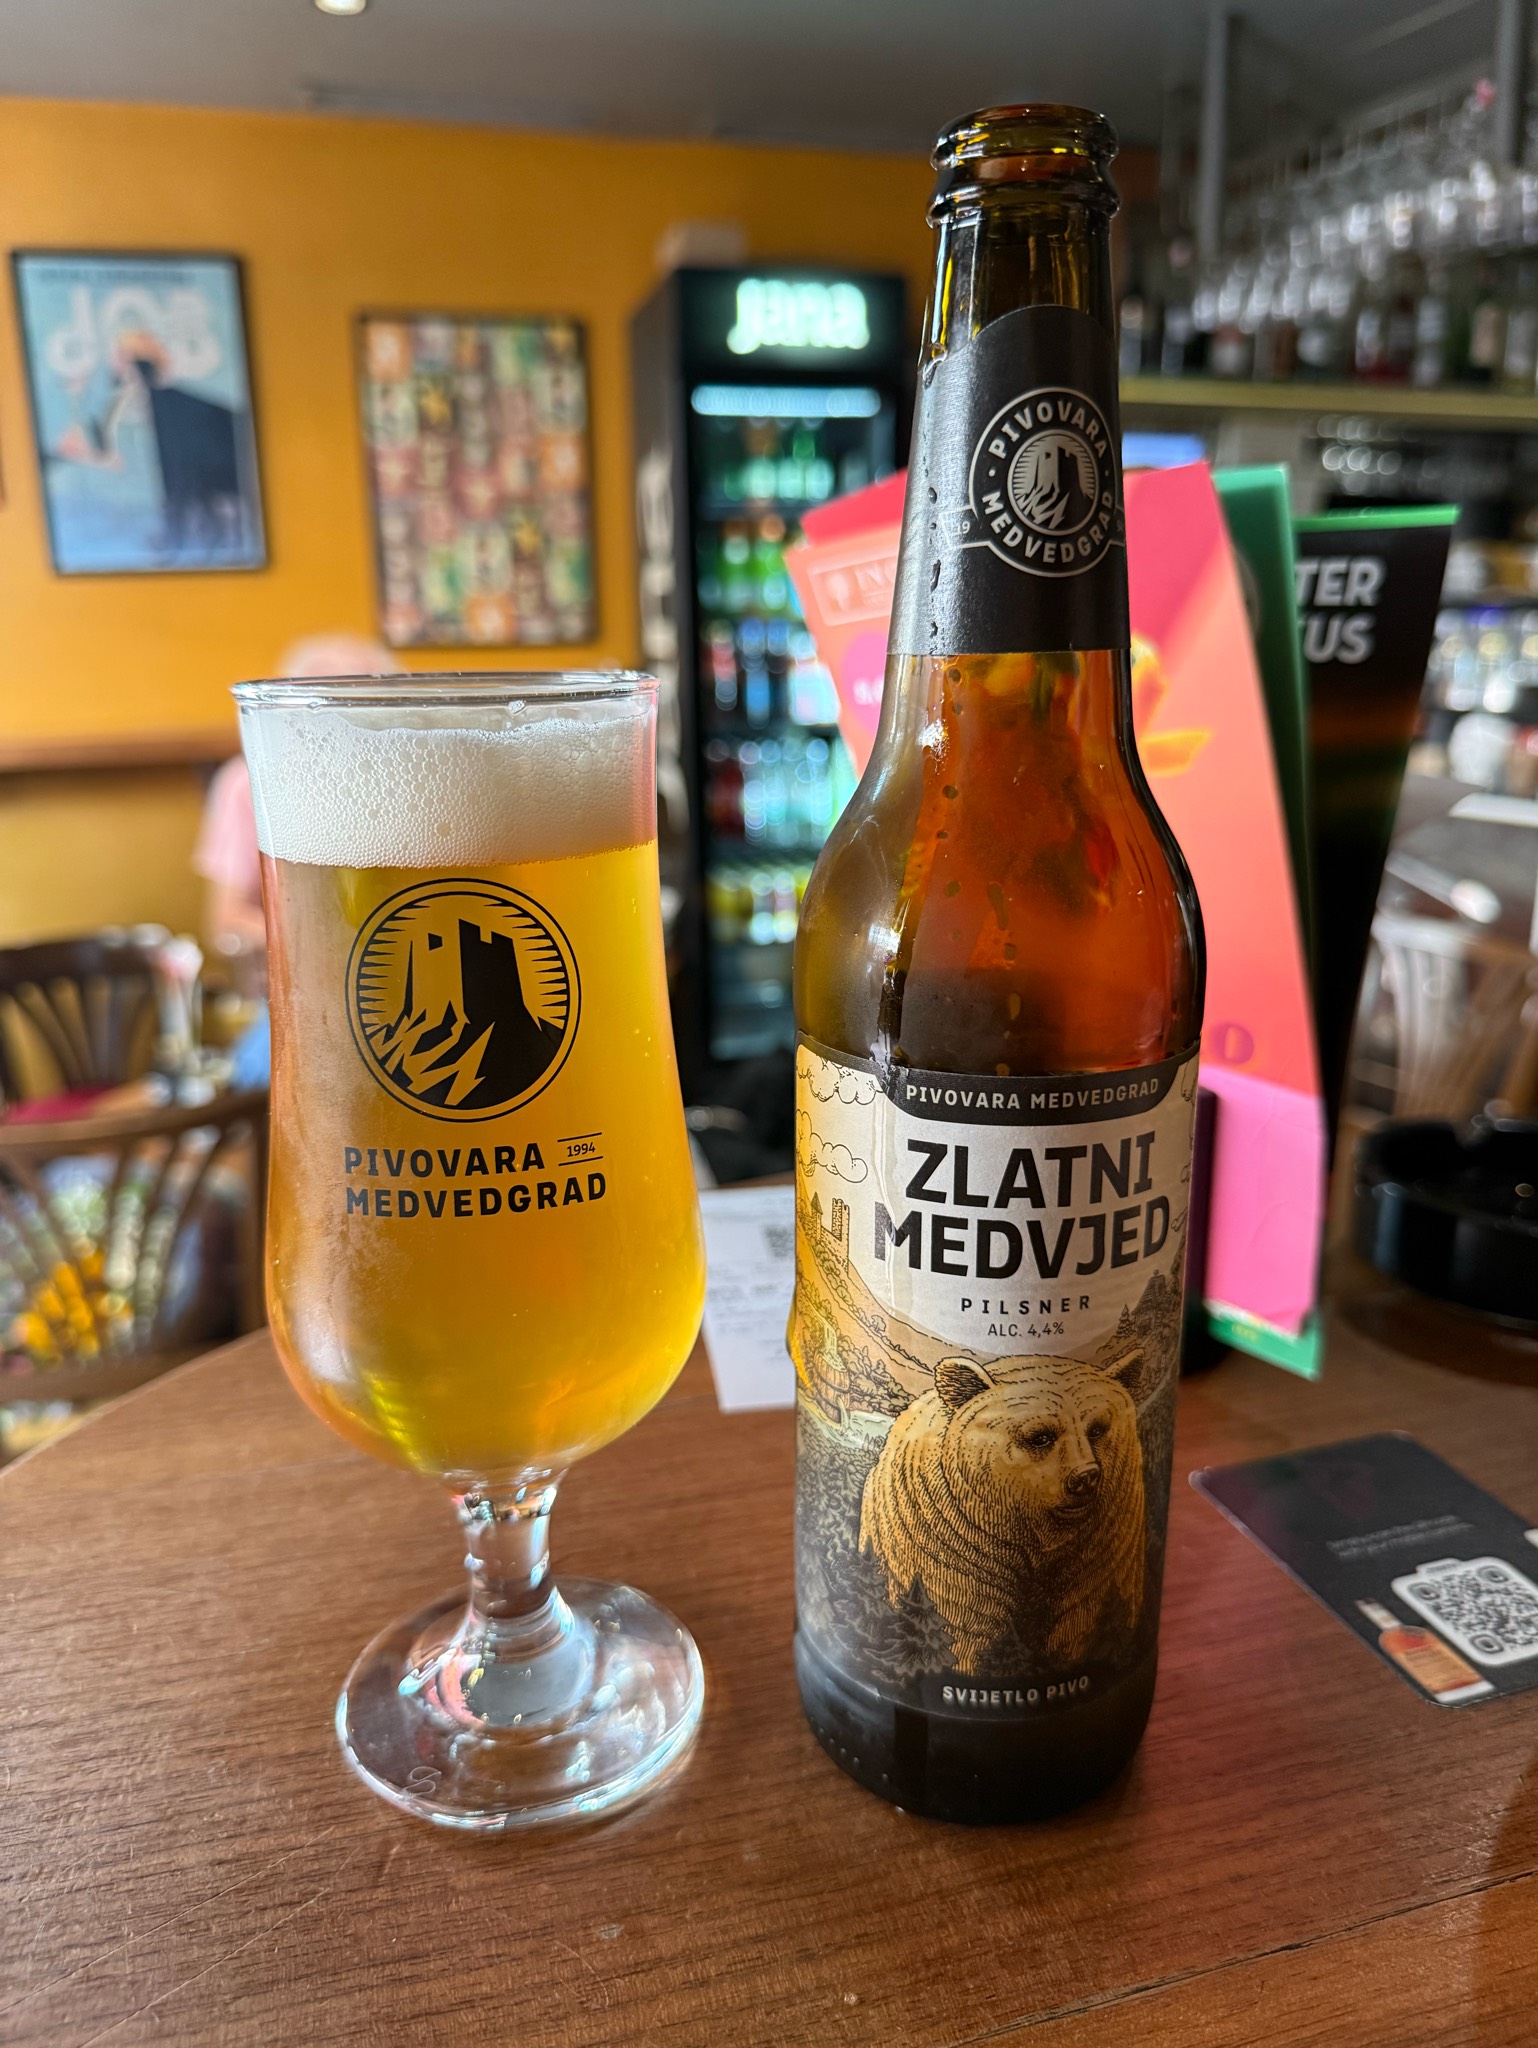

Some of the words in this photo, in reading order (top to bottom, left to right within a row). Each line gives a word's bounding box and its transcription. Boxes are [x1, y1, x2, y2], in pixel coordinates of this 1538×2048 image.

[988, 401, 1108, 459] PIVOVARA
[982, 491, 1113, 564] MEDVEDGRAD
[1297, 614, 1374, 664] US
[907, 1084, 1020, 1110] PIVOVARA
[1030, 1078, 1159, 1110] MEDVEDGRAD
[344, 1142, 545, 1177] PIVOVARA
[566, 1141, 596, 1158] 1994
[905, 1130, 1155, 1209] ZLATNI
[346, 1172, 606, 1218] MEDVEDGRAD
[874, 1194, 1170, 1280] MEDVJED
[961, 1295, 1090, 1315] PILSNER
[987, 1323, 1022, 1337] ALC.
[1027, 1321, 1064, 1338] 4,4%
[942, 1685, 1038, 1704] SVIJETLO
[1046, 1675, 1090, 1699] PIVO
